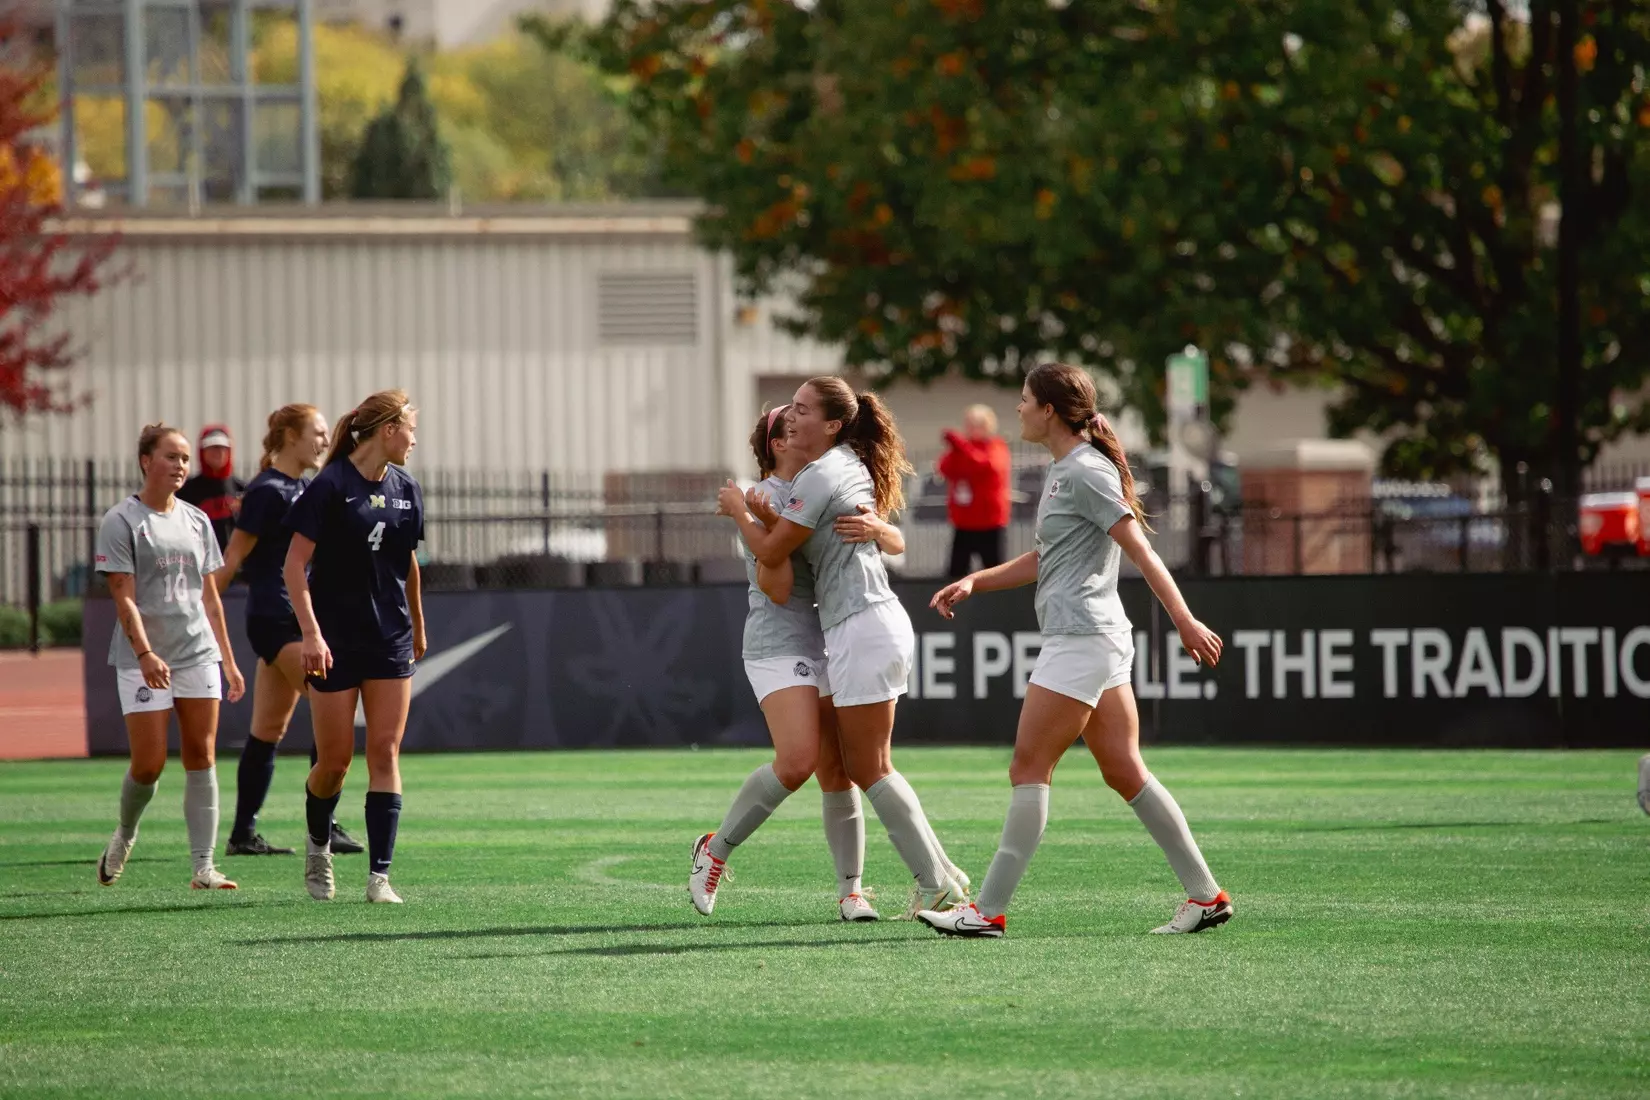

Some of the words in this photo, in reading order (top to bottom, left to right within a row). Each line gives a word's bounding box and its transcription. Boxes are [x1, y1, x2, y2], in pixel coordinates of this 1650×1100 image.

[367, 521, 386, 551] 4
[972, 631, 1218, 700] PELE.
[1232, 629, 1355, 699] THE
